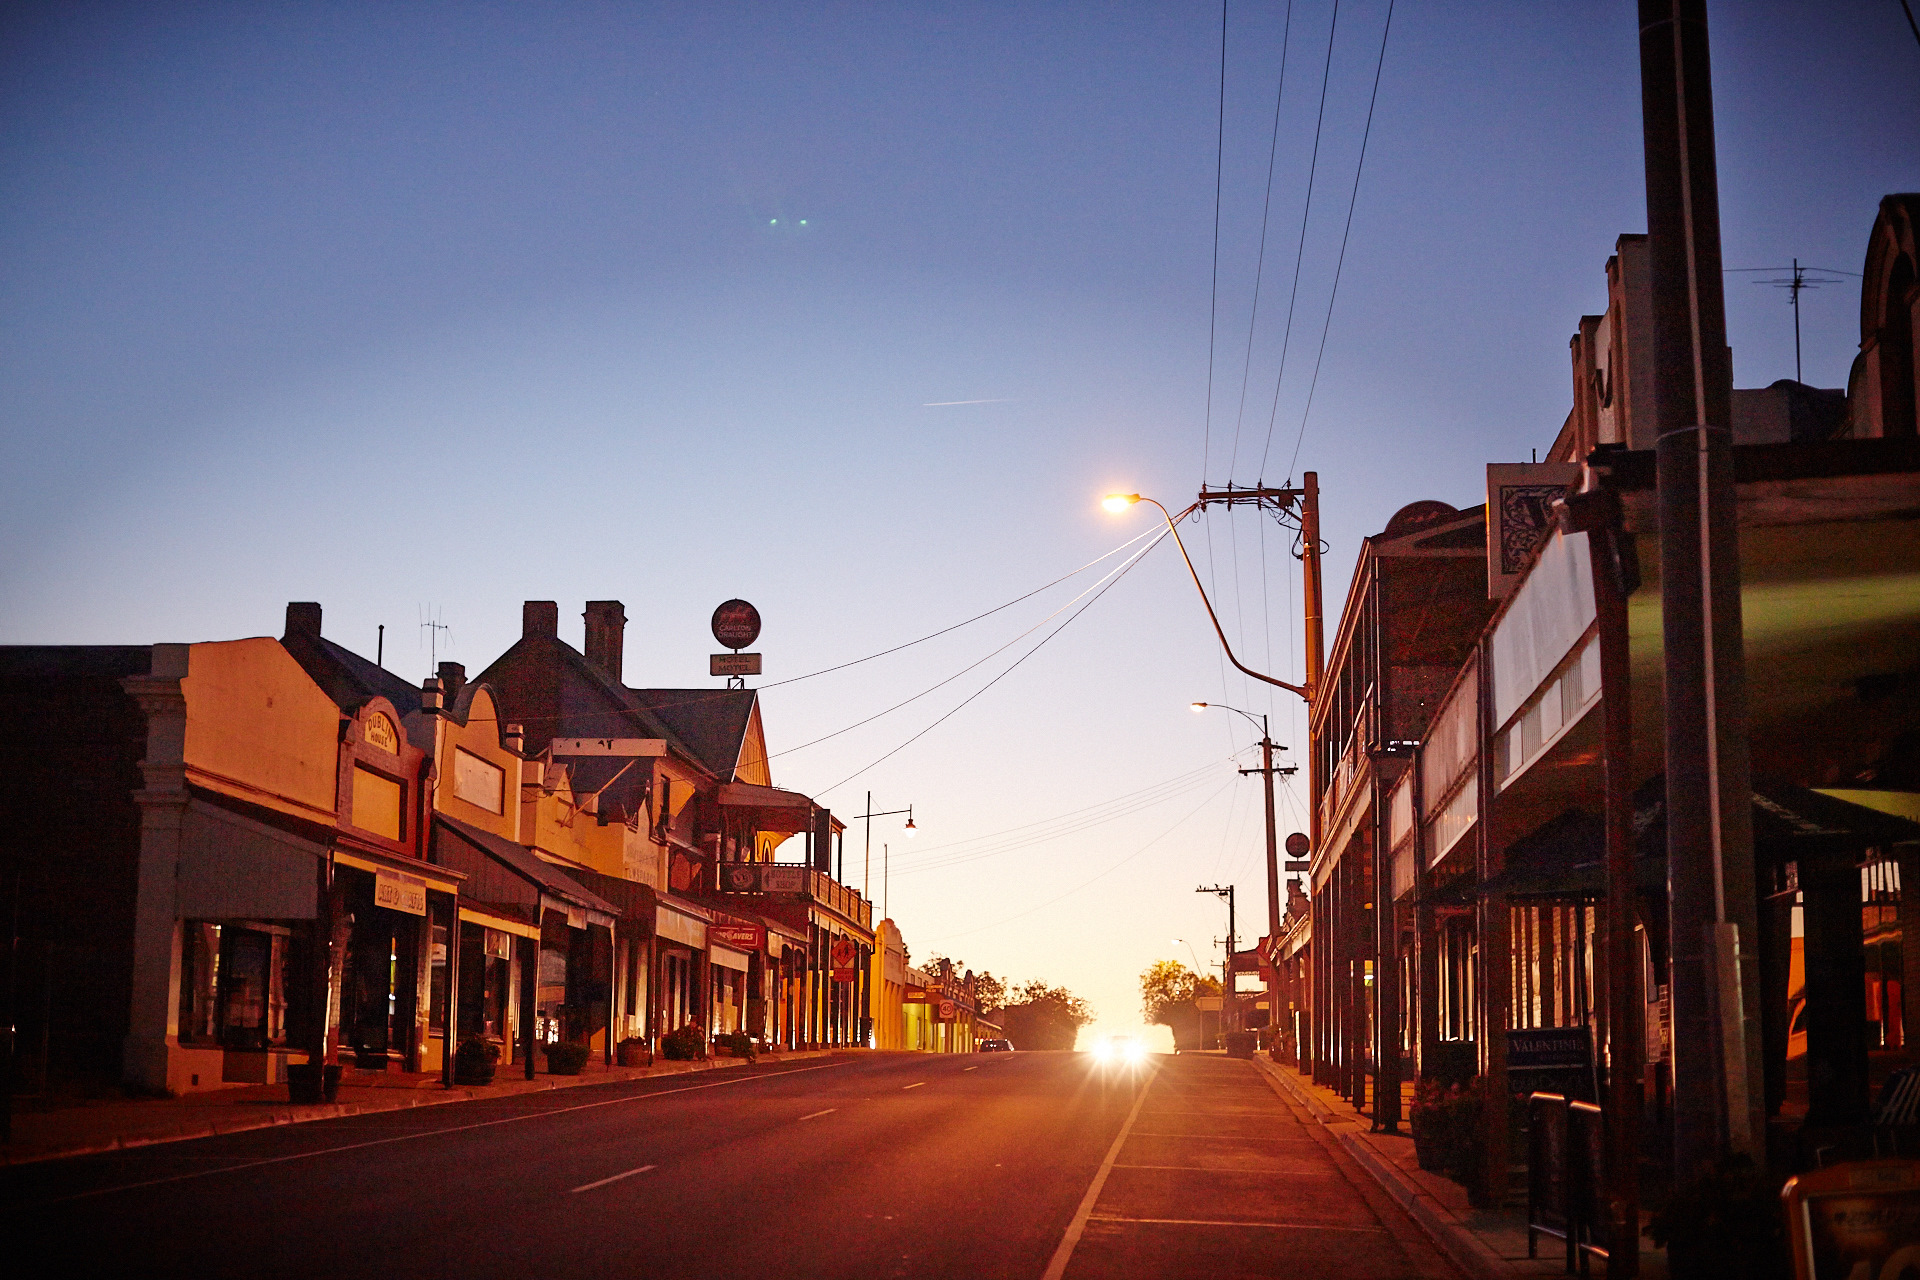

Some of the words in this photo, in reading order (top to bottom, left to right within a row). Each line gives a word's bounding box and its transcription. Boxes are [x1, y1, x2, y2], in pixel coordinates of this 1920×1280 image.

[367, 715, 393, 742] DUBLIN
[370, 733, 388, 747] HOUSE
[771, 869, 802, 878] BOTTLE
[776, 880, 796, 888] SHOP
